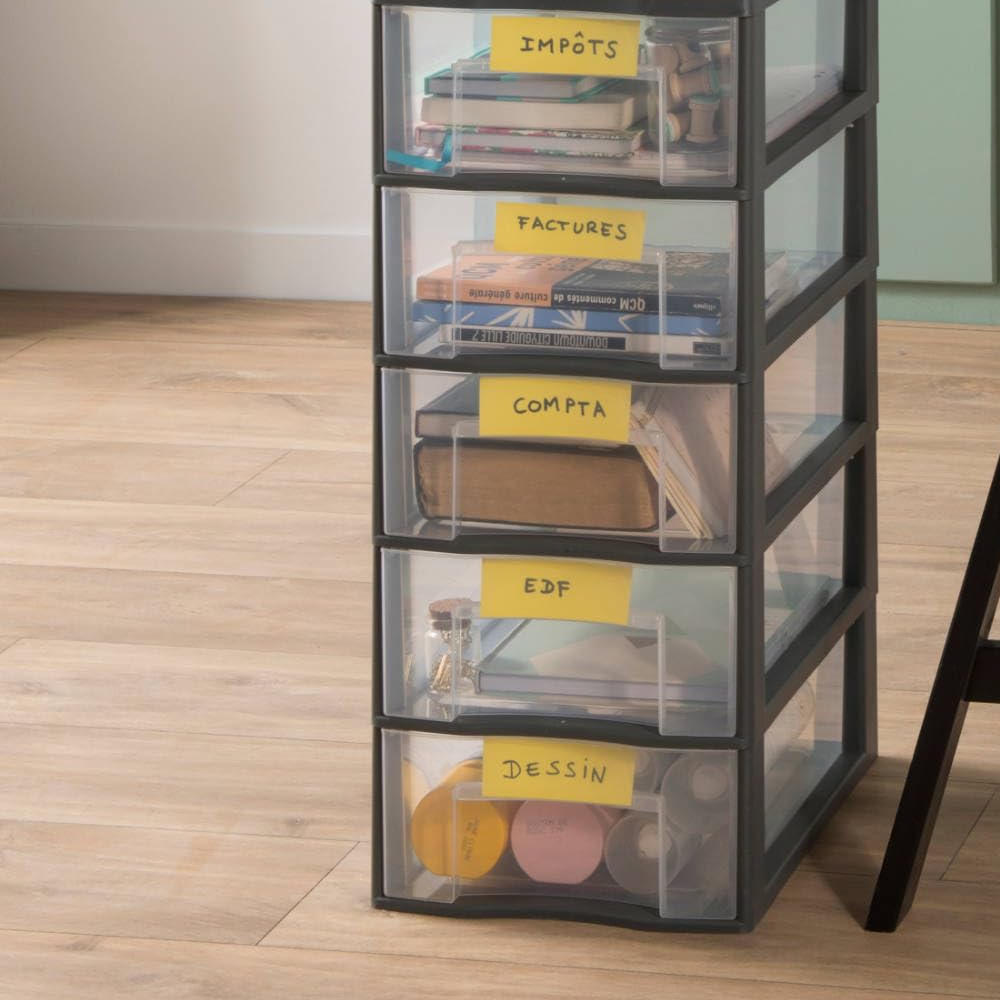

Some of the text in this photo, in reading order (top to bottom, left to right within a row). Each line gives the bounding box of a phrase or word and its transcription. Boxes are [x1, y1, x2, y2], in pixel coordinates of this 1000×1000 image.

[520, 31, 618, 59] IMPÔTS
[517, 215, 627, 241] FACTURES
[468, 287, 646, 312] QCM commentés de culture générale
[505, 330, 551, 346] CITYGUIDE
[513, 396, 607, 418] COMPTA
[524, 577, 570, 598] EDF
